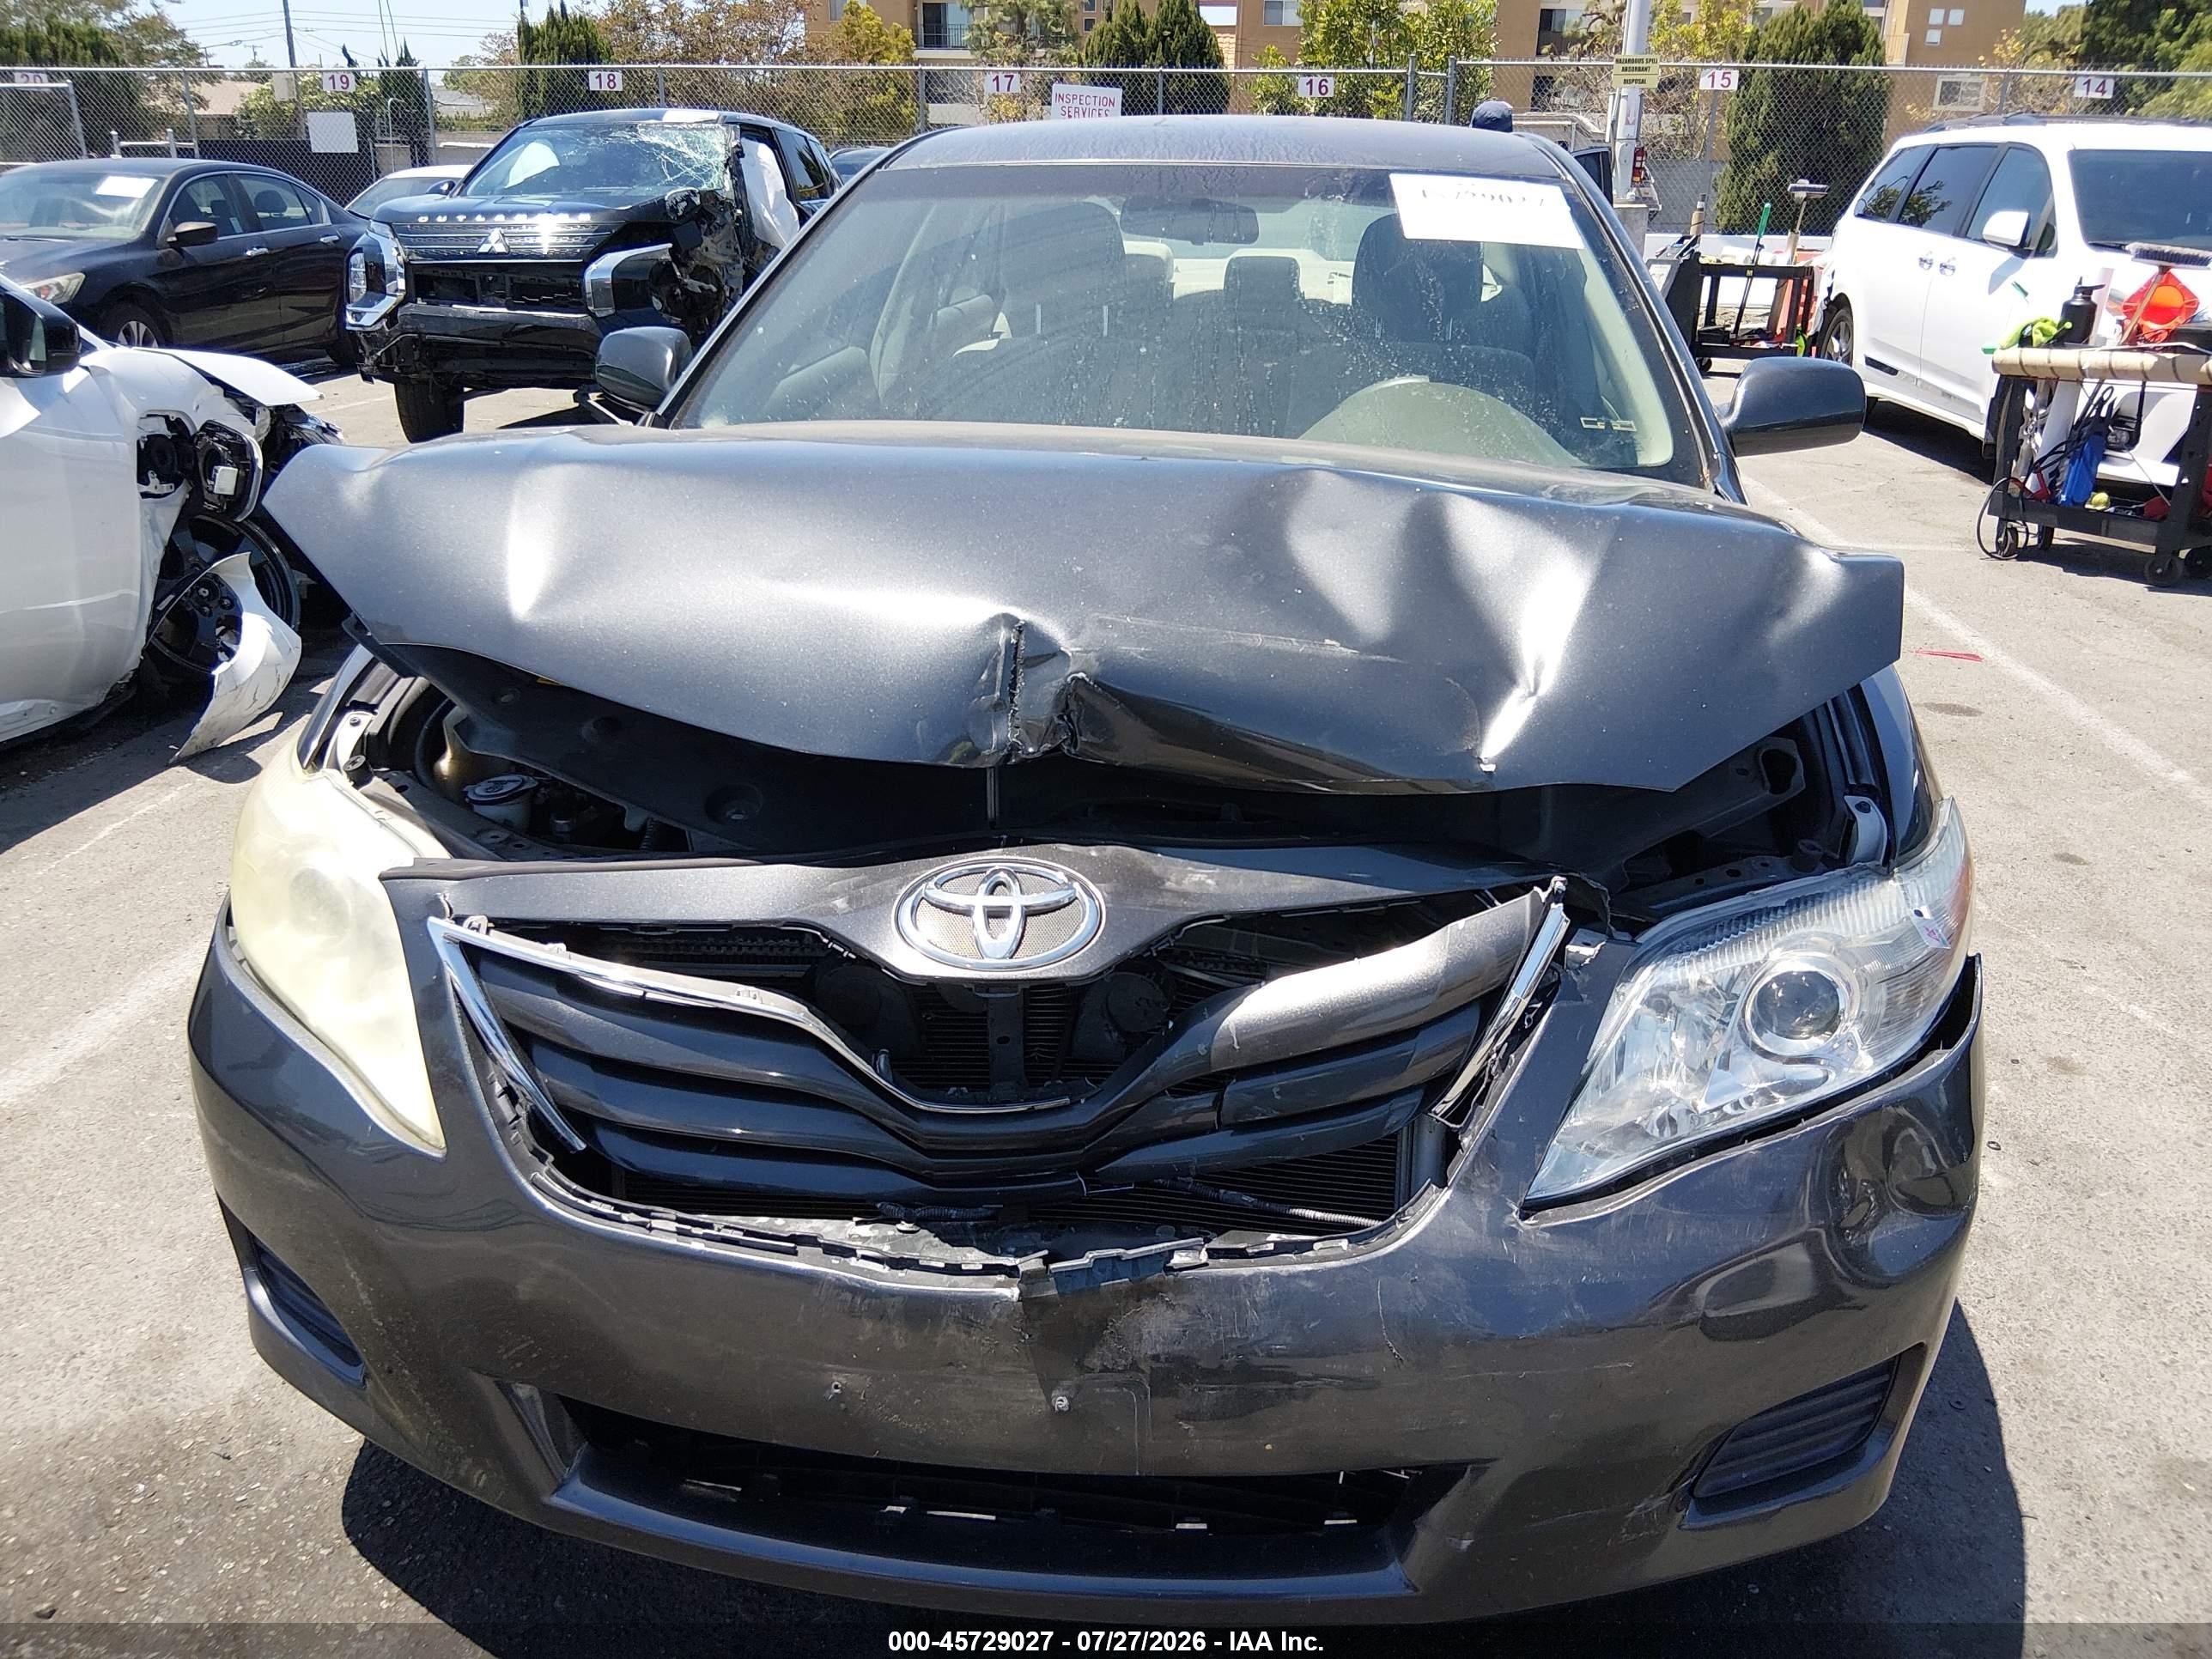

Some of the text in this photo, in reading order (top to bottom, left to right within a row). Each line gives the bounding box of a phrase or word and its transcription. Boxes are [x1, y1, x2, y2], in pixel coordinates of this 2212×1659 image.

[328, 74, 350, 90] 19
[595, 72, 617, 90] 18
[992, 74, 1015, 93] 17
[1305, 78, 1329, 96] 16
[1707, 71, 1732, 88] 15
[2082, 78, 2107, 96] 14
[1054, 92, 1115, 107] INSPECTION
[1060, 106, 1110, 118] SERVICES
[417, 213, 592, 222] OUTLA
